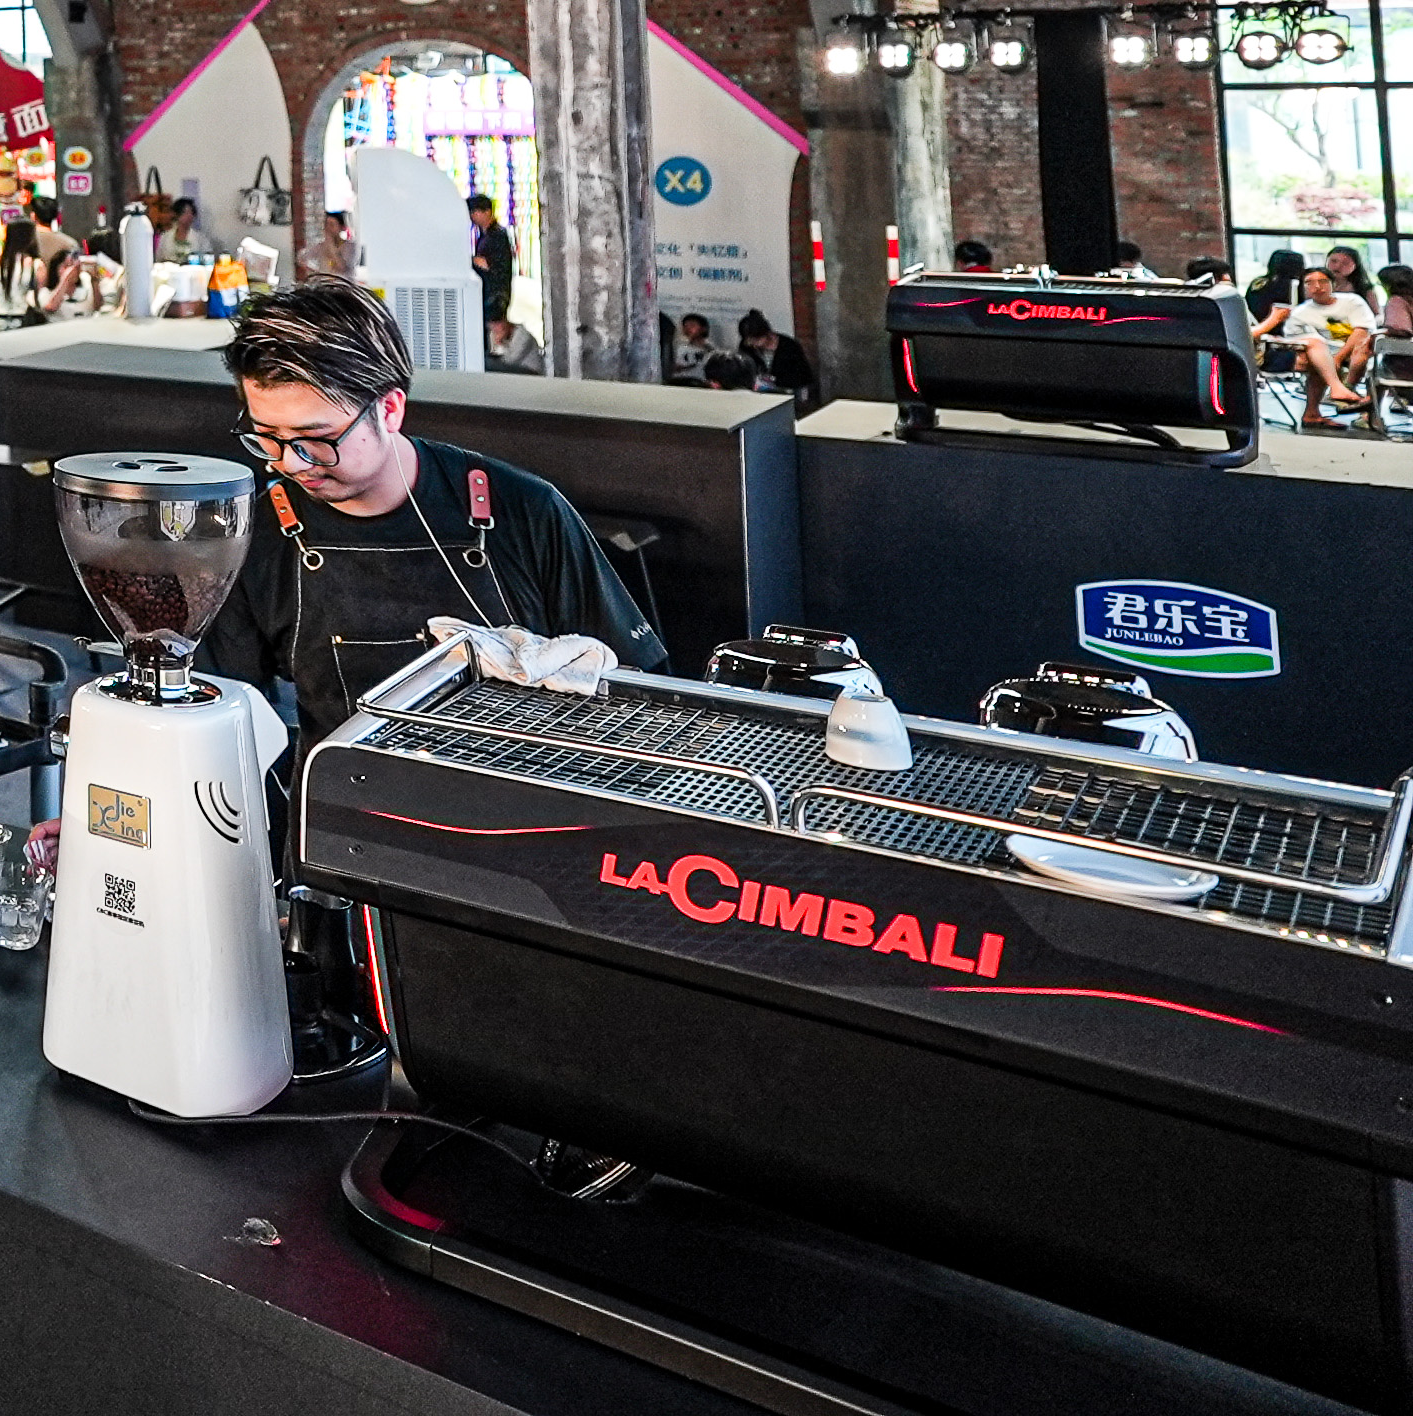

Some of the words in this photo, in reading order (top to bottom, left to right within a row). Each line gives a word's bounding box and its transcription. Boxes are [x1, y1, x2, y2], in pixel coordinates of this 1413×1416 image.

[664, 169, 703, 193] X4
[1103, 592, 1250, 642] 君乐宝
[1105, 626, 1184, 647] JUNLEBAO
